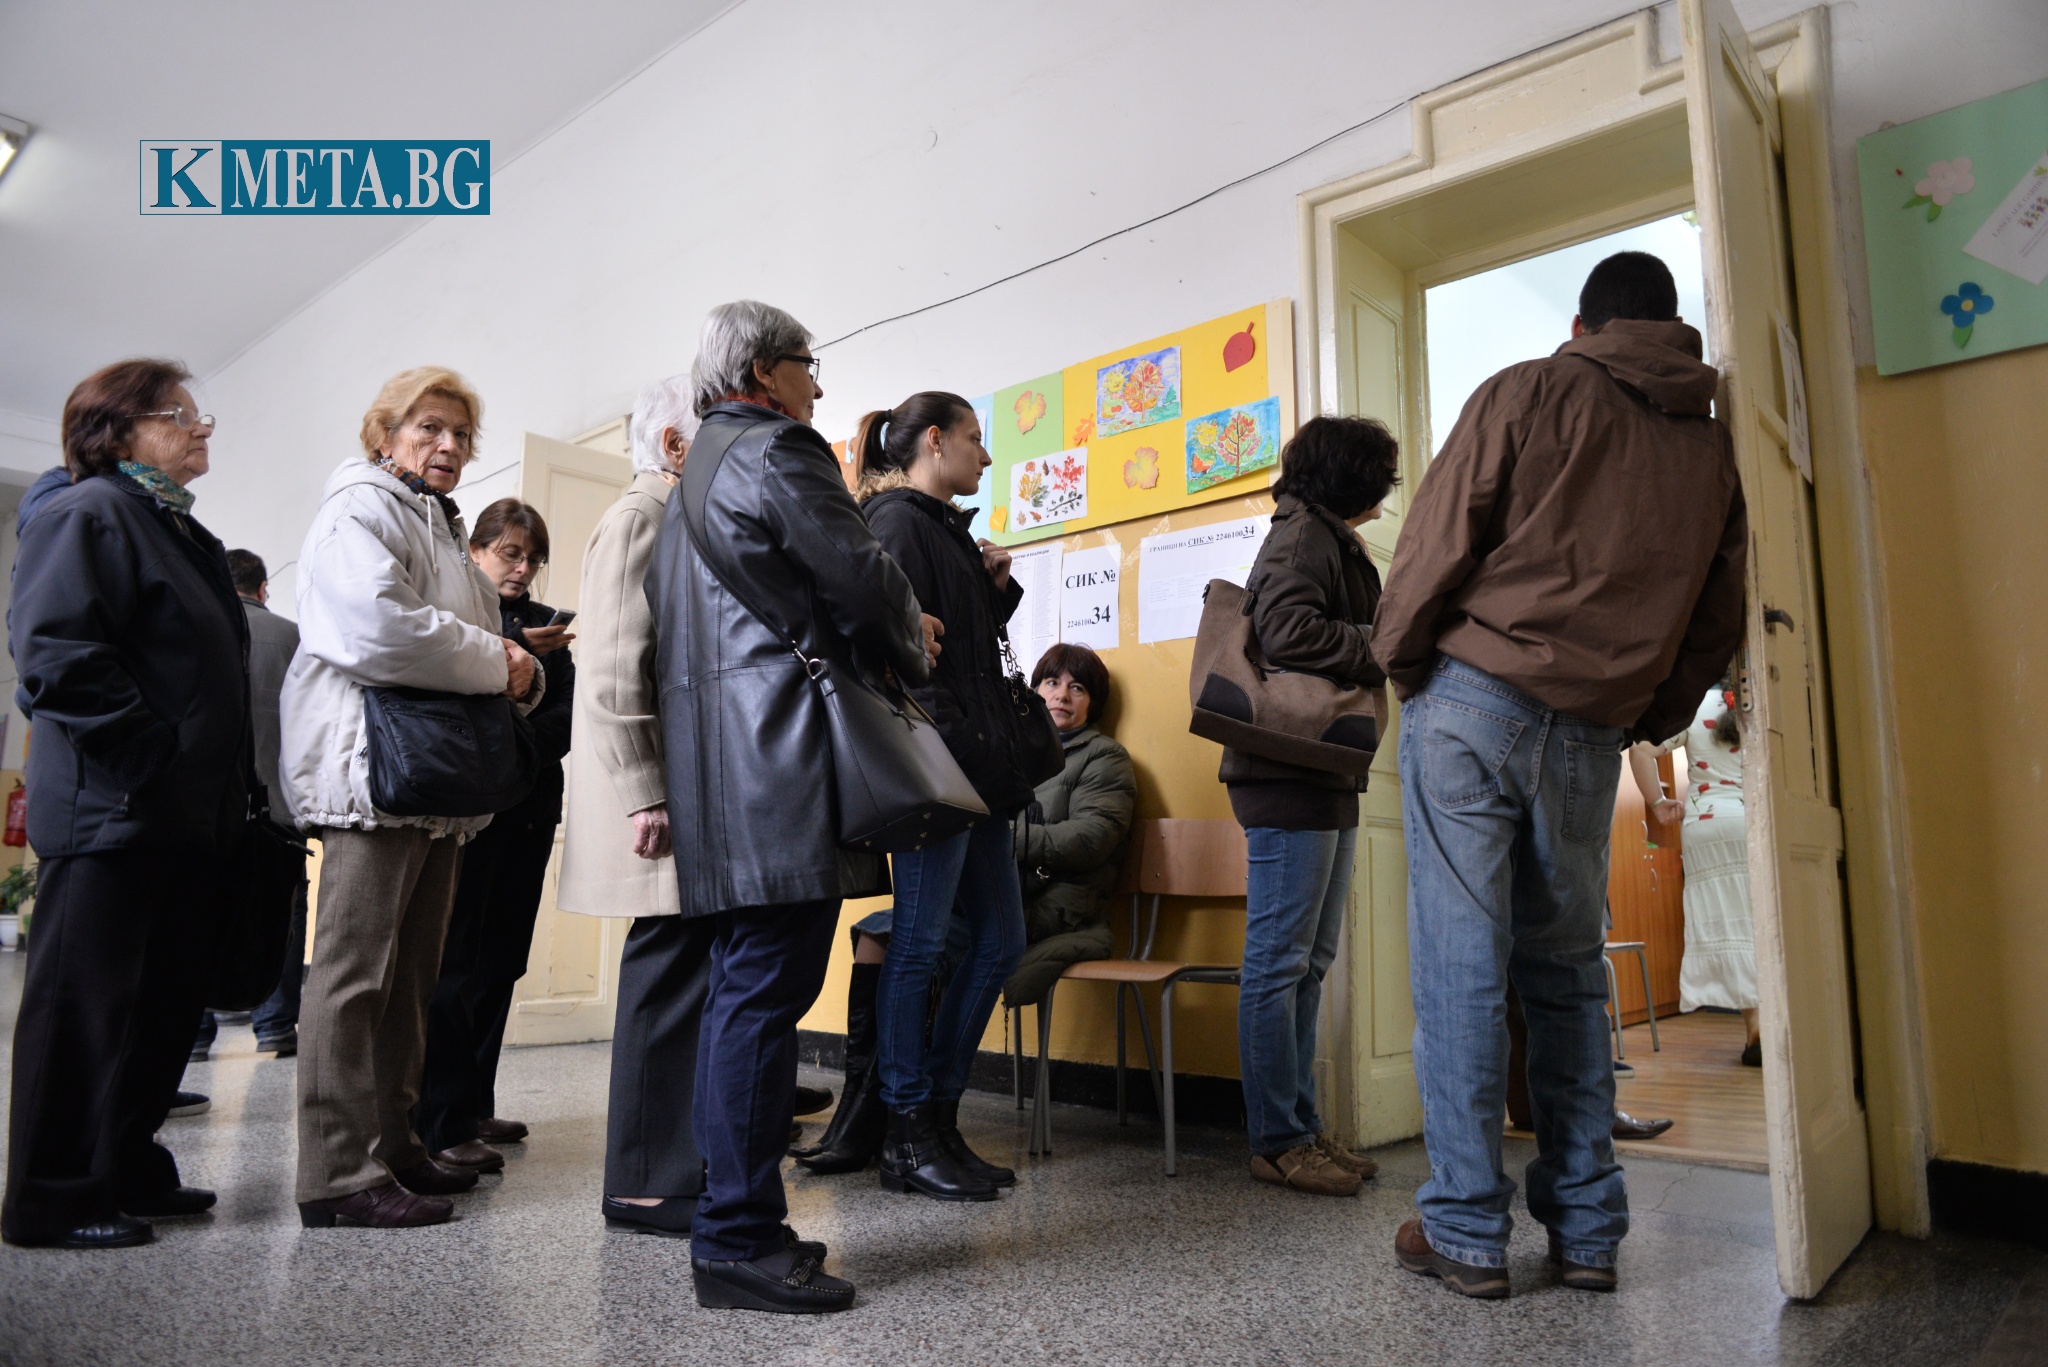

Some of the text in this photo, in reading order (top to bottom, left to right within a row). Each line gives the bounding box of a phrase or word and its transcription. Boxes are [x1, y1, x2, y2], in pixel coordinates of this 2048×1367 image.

[1150, 543, 1179, 553] ГРАНИЦИ
[1187, 536, 1206, 547] СИК
[1215, 525, 1255, 541] 224610034
[1065, 569, 1116, 589] СИК №
[1067, 604, 1111, 628] 224610034
